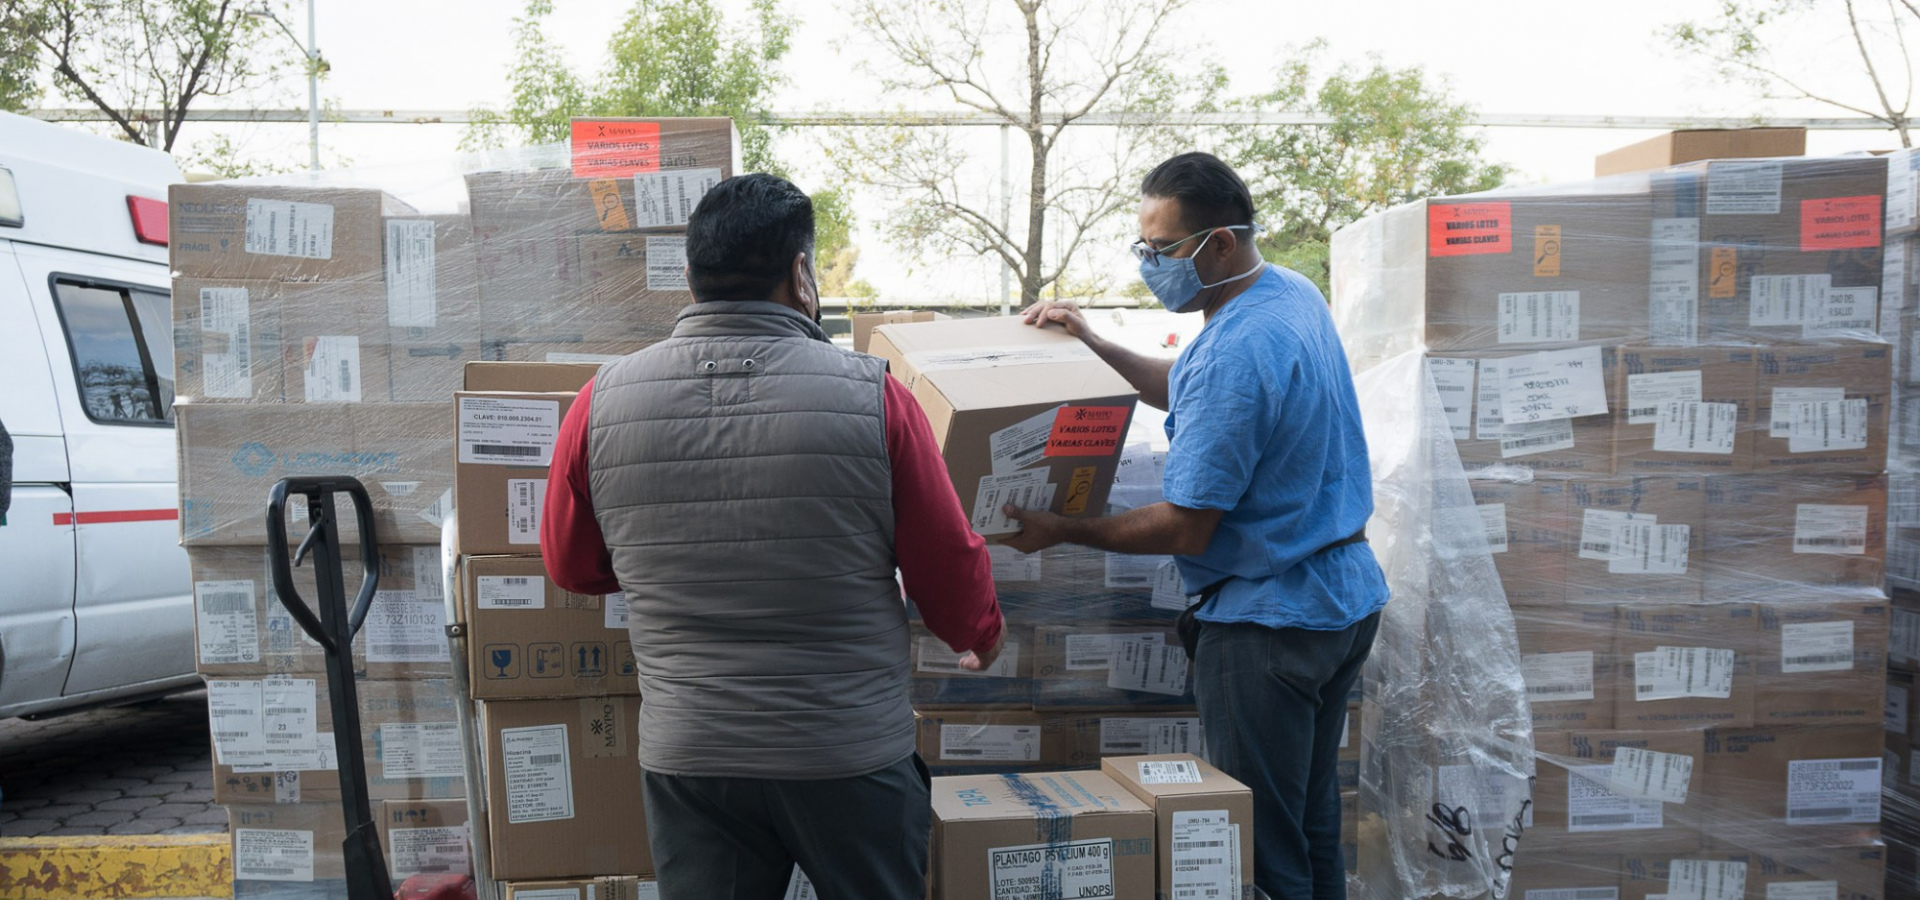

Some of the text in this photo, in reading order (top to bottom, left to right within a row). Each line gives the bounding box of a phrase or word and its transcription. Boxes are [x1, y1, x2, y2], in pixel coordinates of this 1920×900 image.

[588, 141, 650, 150] VARIOS LOTES
[620, 158, 650, 166] CLAVES
[1814, 214, 1871, 224] VARIOS LOTES
[1446, 220, 1499, 230] VARIOS LOTES
[1446, 234, 1500, 245] VARIAS CLAVES
[1814, 230, 1871, 240] VARIAS CLAVES
[1088, 410, 1112, 418] MAYPO
[1092, 425, 1117, 433] LOTES
[1051, 439, 1116, 448] VARIAS CLAVES
[604, 704, 616, 747] MAYPO
[995, 851, 1041, 866] PLANTAGO
[1088, 846, 1101, 857] 400
[1103, 847, 1108, 859] g
[997, 878, 1017, 887] LOTE:
[997, 886, 1032, 895] CANTIDAD:
[1079, 885, 1110, 897] UNOPS
